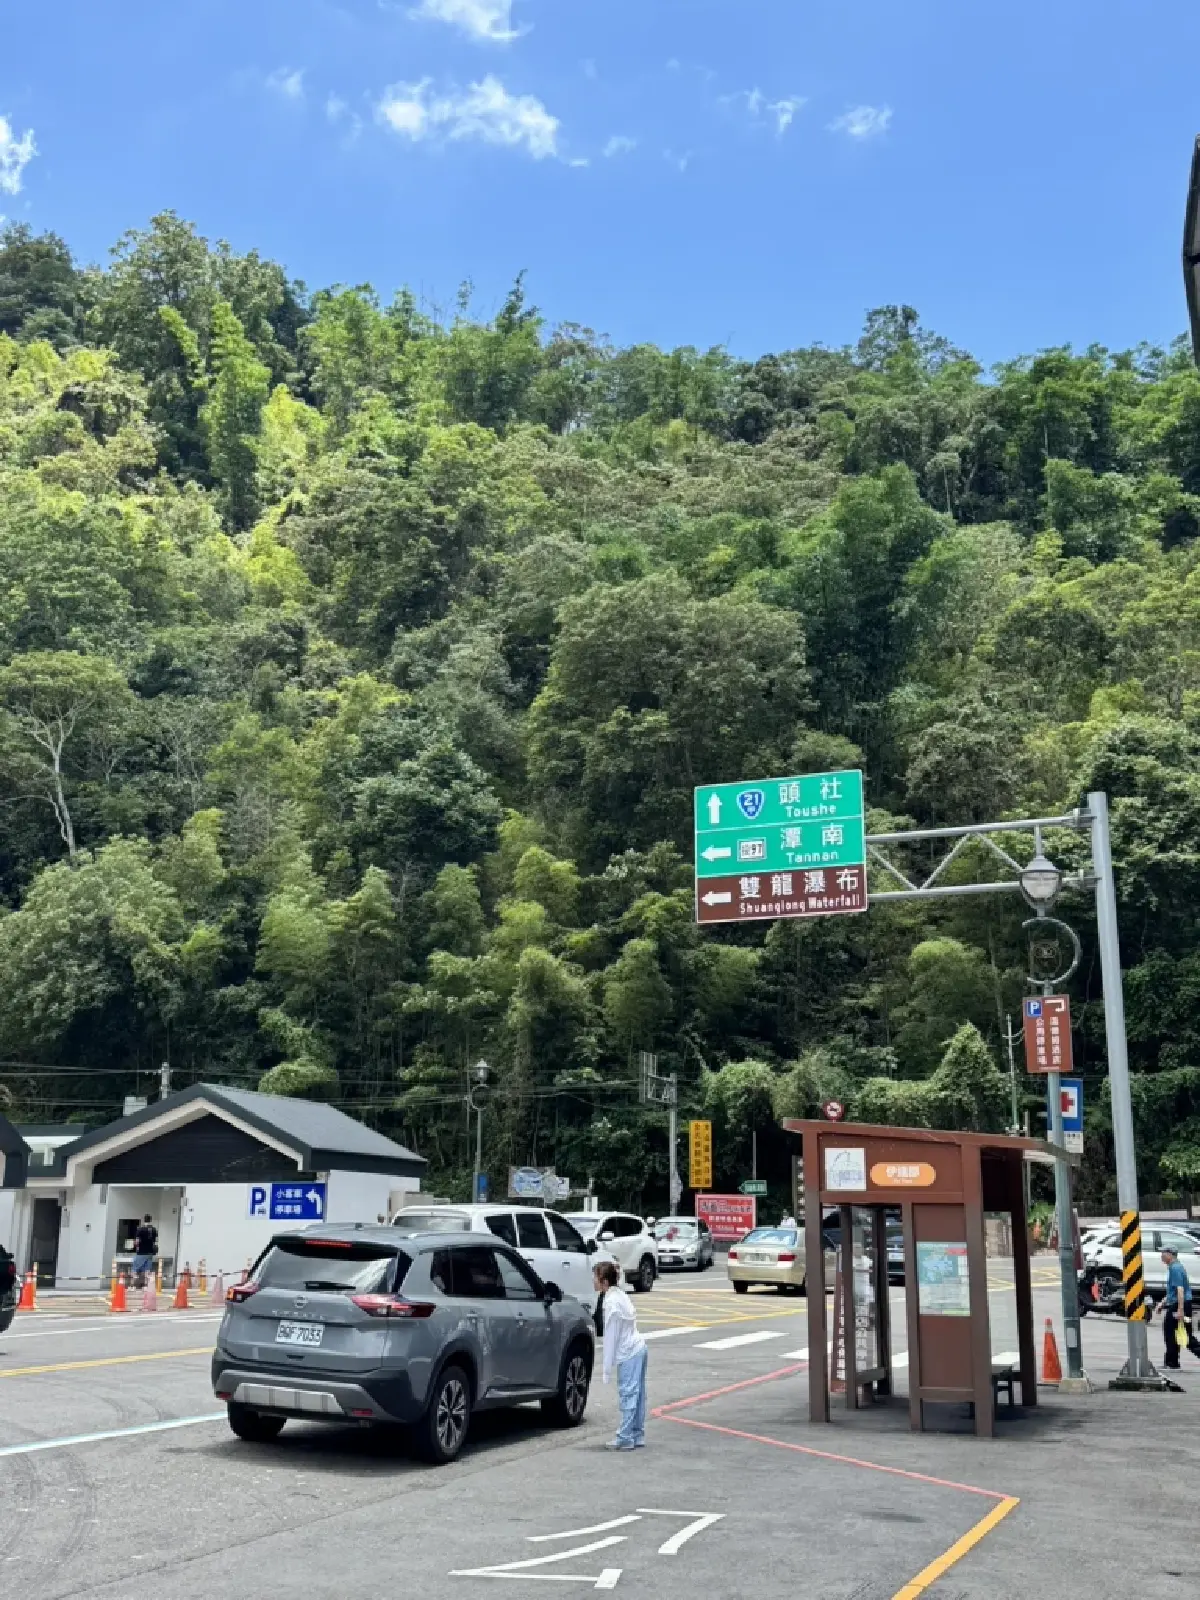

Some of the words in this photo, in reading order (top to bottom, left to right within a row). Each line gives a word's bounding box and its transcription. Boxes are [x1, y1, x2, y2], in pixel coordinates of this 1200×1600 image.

[743, 794, 759, 806] 21
[778, 777, 843, 805] 頭社
[786, 803, 837, 817] Toushe
[780, 823, 844, 850] 潭南
[786, 850, 839, 865] Tannan
[739, 868, 859, 899] 雙龍瀑布
[740, 899, 806, 915] Shuanglong
[808, 894, 860, 909] Waterfall
[1030, 1001, 1040, 1015] P
[250, 1187, 266, 1216] P
